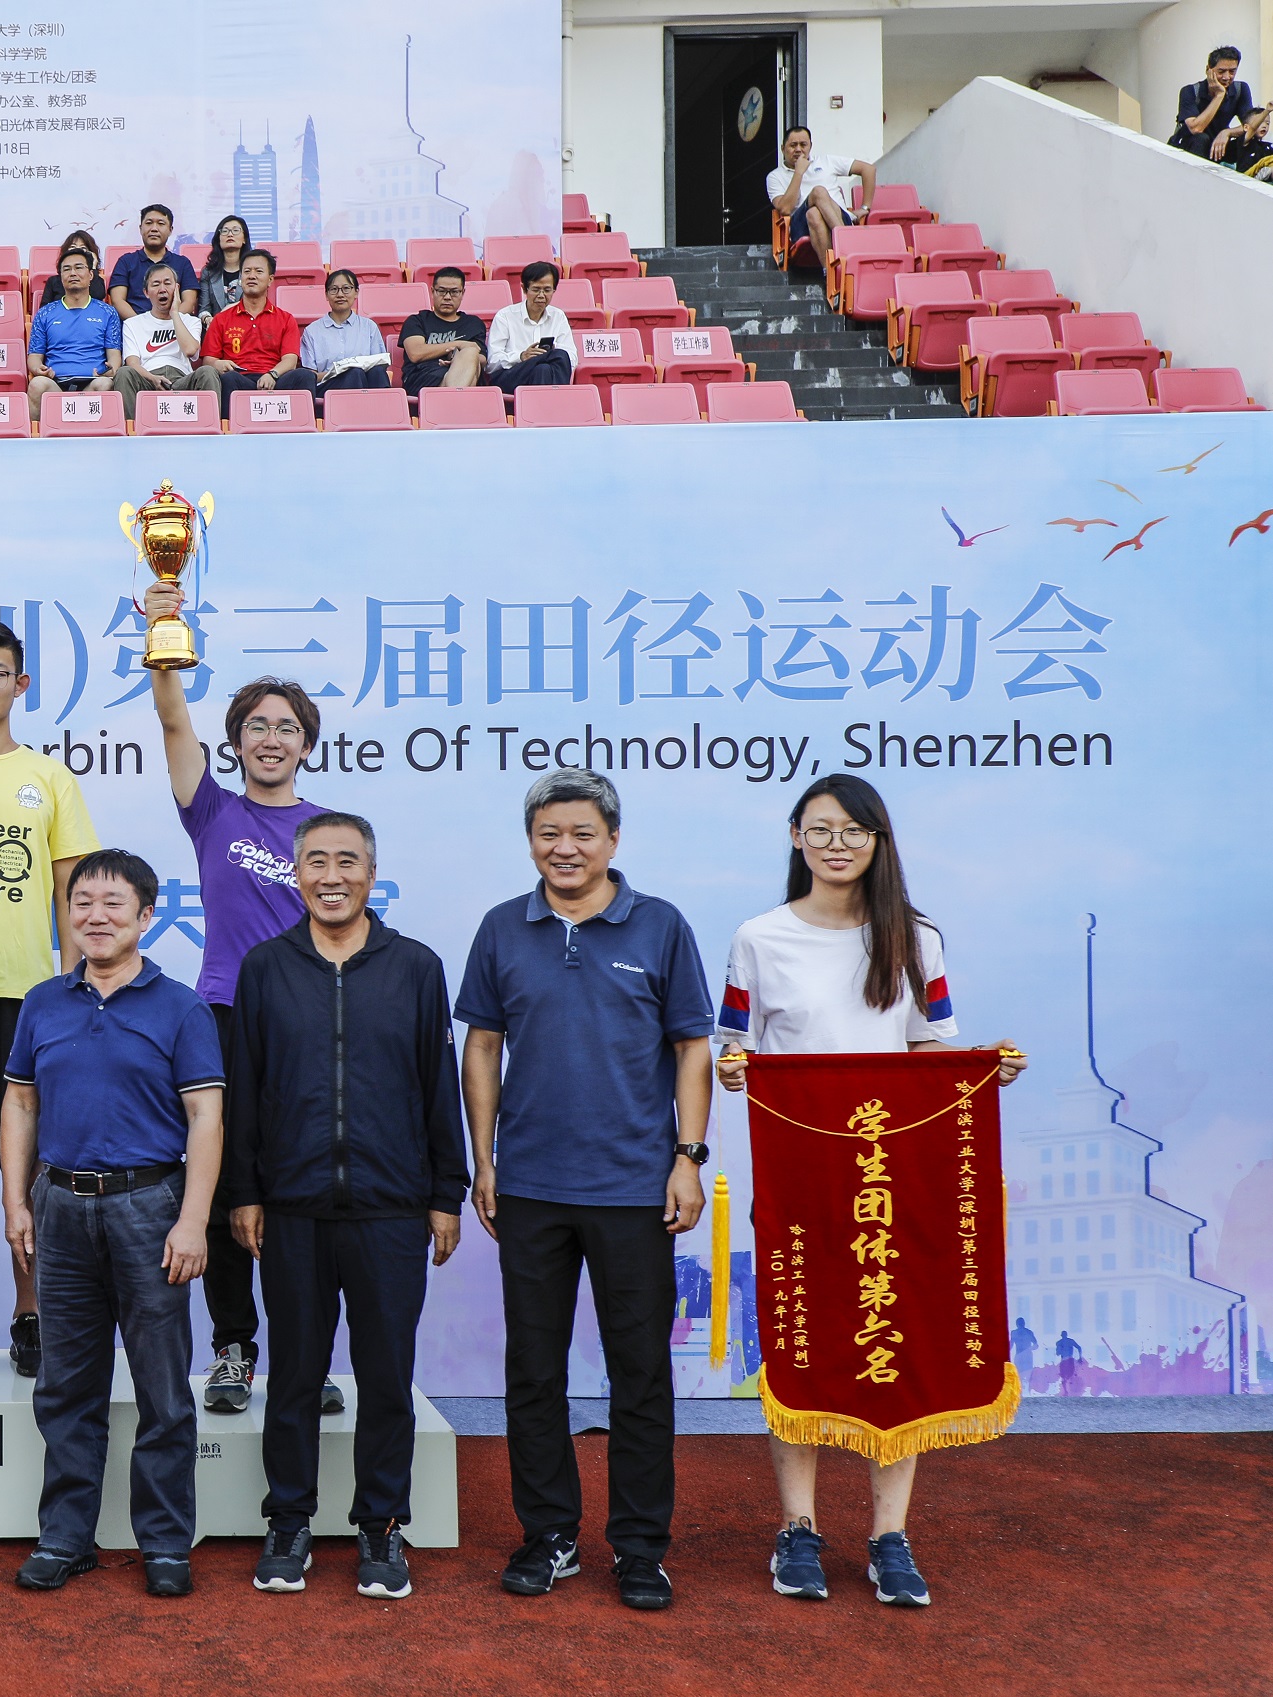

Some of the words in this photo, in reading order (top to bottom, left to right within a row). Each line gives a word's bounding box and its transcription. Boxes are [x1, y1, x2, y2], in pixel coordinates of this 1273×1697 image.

[232, 337, 241, 354] 8
[584, 338, 620, 353] 教务部
[673, 336, 710, 350] 学生工作部
[252, 400, 288, 415] 马广富
[42, 729, 143, 776] rbin
[405, 725, 471, 772] Of
[487, 722, 821, 784] Technology,
[843, 720, 1113, 769] Shenzhen
[847, 1098, 904, 1384] 学生团体第六名
[789, 1224, 810, 1369] 哈尔滨工业大学(深圳)
[196, 1442, 221, 1454] 体育
